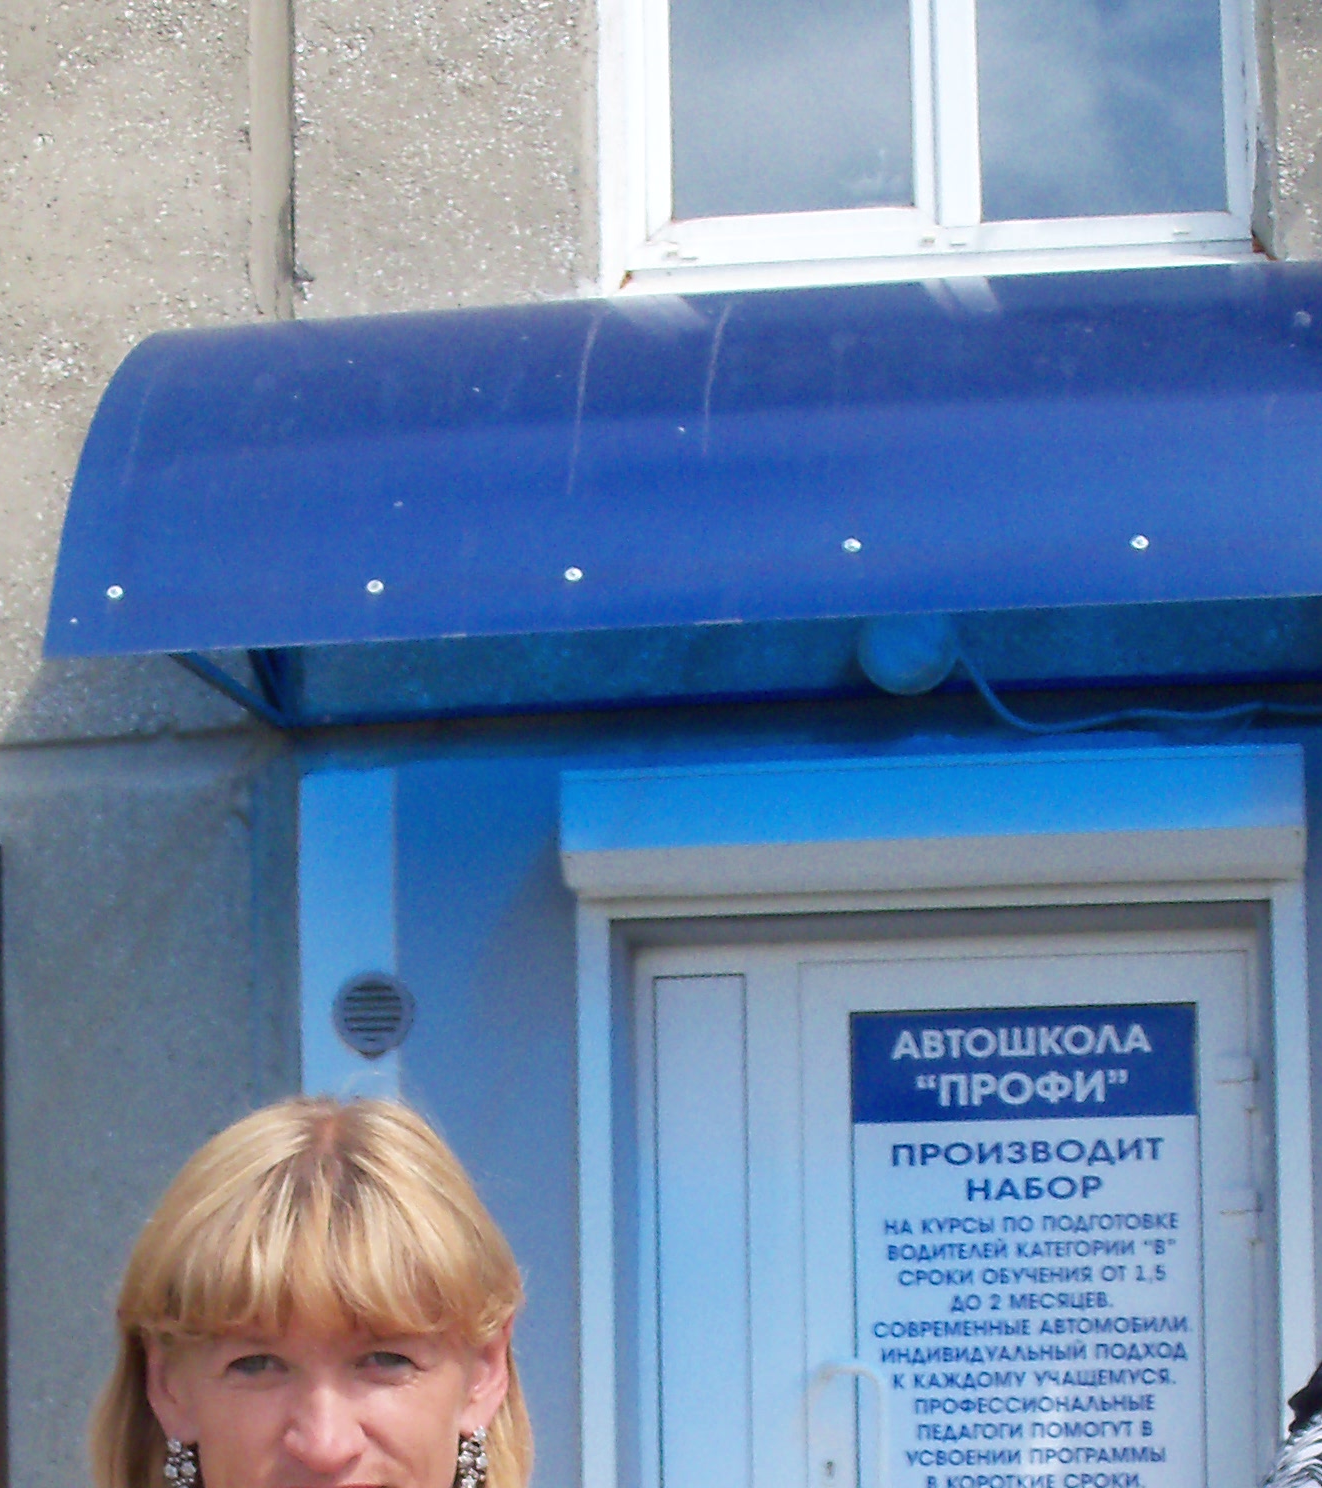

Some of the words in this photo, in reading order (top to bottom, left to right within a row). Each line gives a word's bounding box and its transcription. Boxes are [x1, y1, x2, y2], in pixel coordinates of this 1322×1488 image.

[890, 1023, 1153, 1060] АВТОШКОЛА
[890, 1136, 1165, 1167] ПРОИЗВОДИТ
[966, 1174, 1103, 1202] НАБОР
[884, 1218, 913, 1236] НА
[920, 1217, 995, 1235] КУРСЫ
[1003, 1215, 1033, 1233] ПО
[1042, 1212, 1179, 1233] ПОДГОТОВКЕ
[886, 1238, 1008, 1262] ВОДИТЕЛЕЙ
[1015, 1238, 1136, 1260] КАТЕГОРИИ
[897, 1269, 974, 1287] СРОКИ
[981, 1265, 1094, 1285] ОБУЧЕНИЯ
[1100, 1265, 1127, 1283] ОТ
[1135, 1264, 1167, 1285] 1,5
[950, 1293, 982, 1313] ДО
[989, 1293, 1002, 1311] 2
[873, 1318, 1031, 1338] СОВРЕМЕННЫЕ
[880, 1339, 1087, 1366] ИНДИВИДУАЛЬНЫЙ
[1094, 1341, 1189, 1362] ПОДХОД
[893, 1372, 906, 1389] К
[913, 1370, 1027, 1390] КАЖДОМУ
[1034, 1367, 1177, 1388] УЧАЩЕМУСЯ.
[913, 1394, 1156, 1415] ПРОФЕССИОНАЛЬНЫЕ
[916, 1422, 1024, 1443] ПЕДАГОГИ
[1030, 1420, 1134, 1439] ПОМОГУТ
[1141, 1420, 1154, 1437] В
[905, 1448, 1021, 1467] УСВОЕНИИ
[1029, 1446, 1167, 1465] ПРОГРАММЫ
